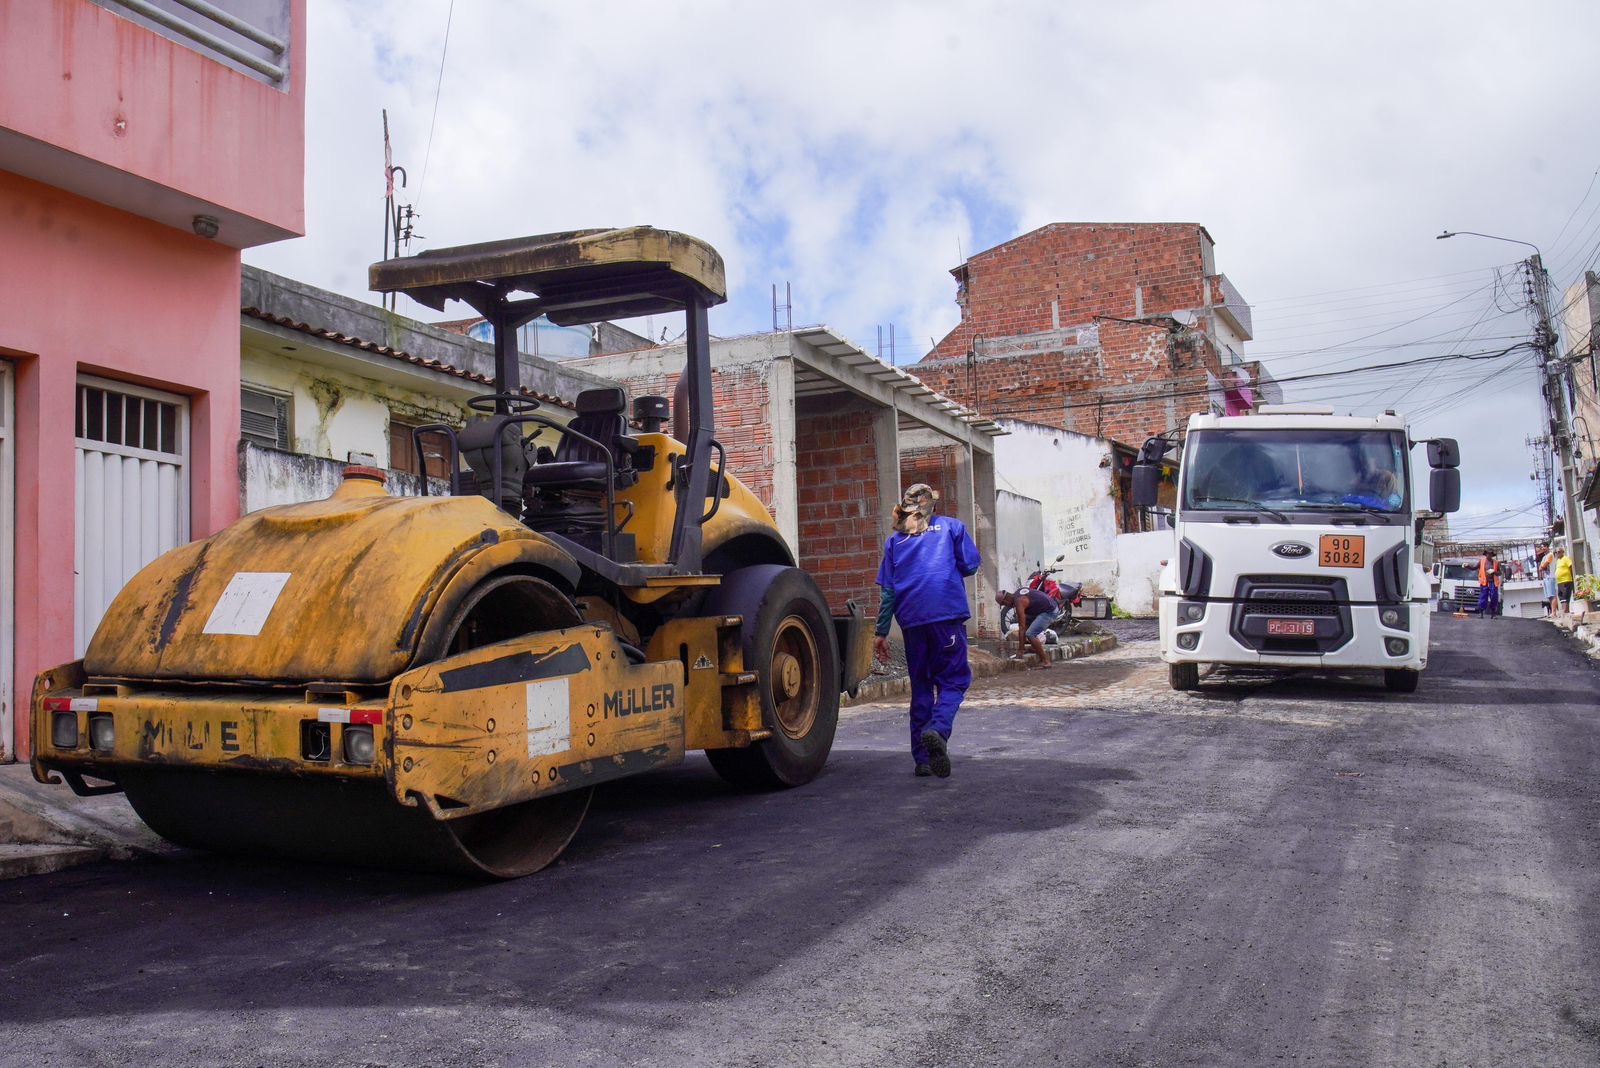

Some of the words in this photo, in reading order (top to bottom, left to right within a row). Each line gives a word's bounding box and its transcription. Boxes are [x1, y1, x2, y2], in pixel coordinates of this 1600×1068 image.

[1075, 543, 1088, 552] ETC
[1280, 544, 1304, 554] Ford
[1332, 539, 1350, 550] 90
[1324, 552, 1359, 564] 3082
[604, 683, 675, 719] MÜLLER
